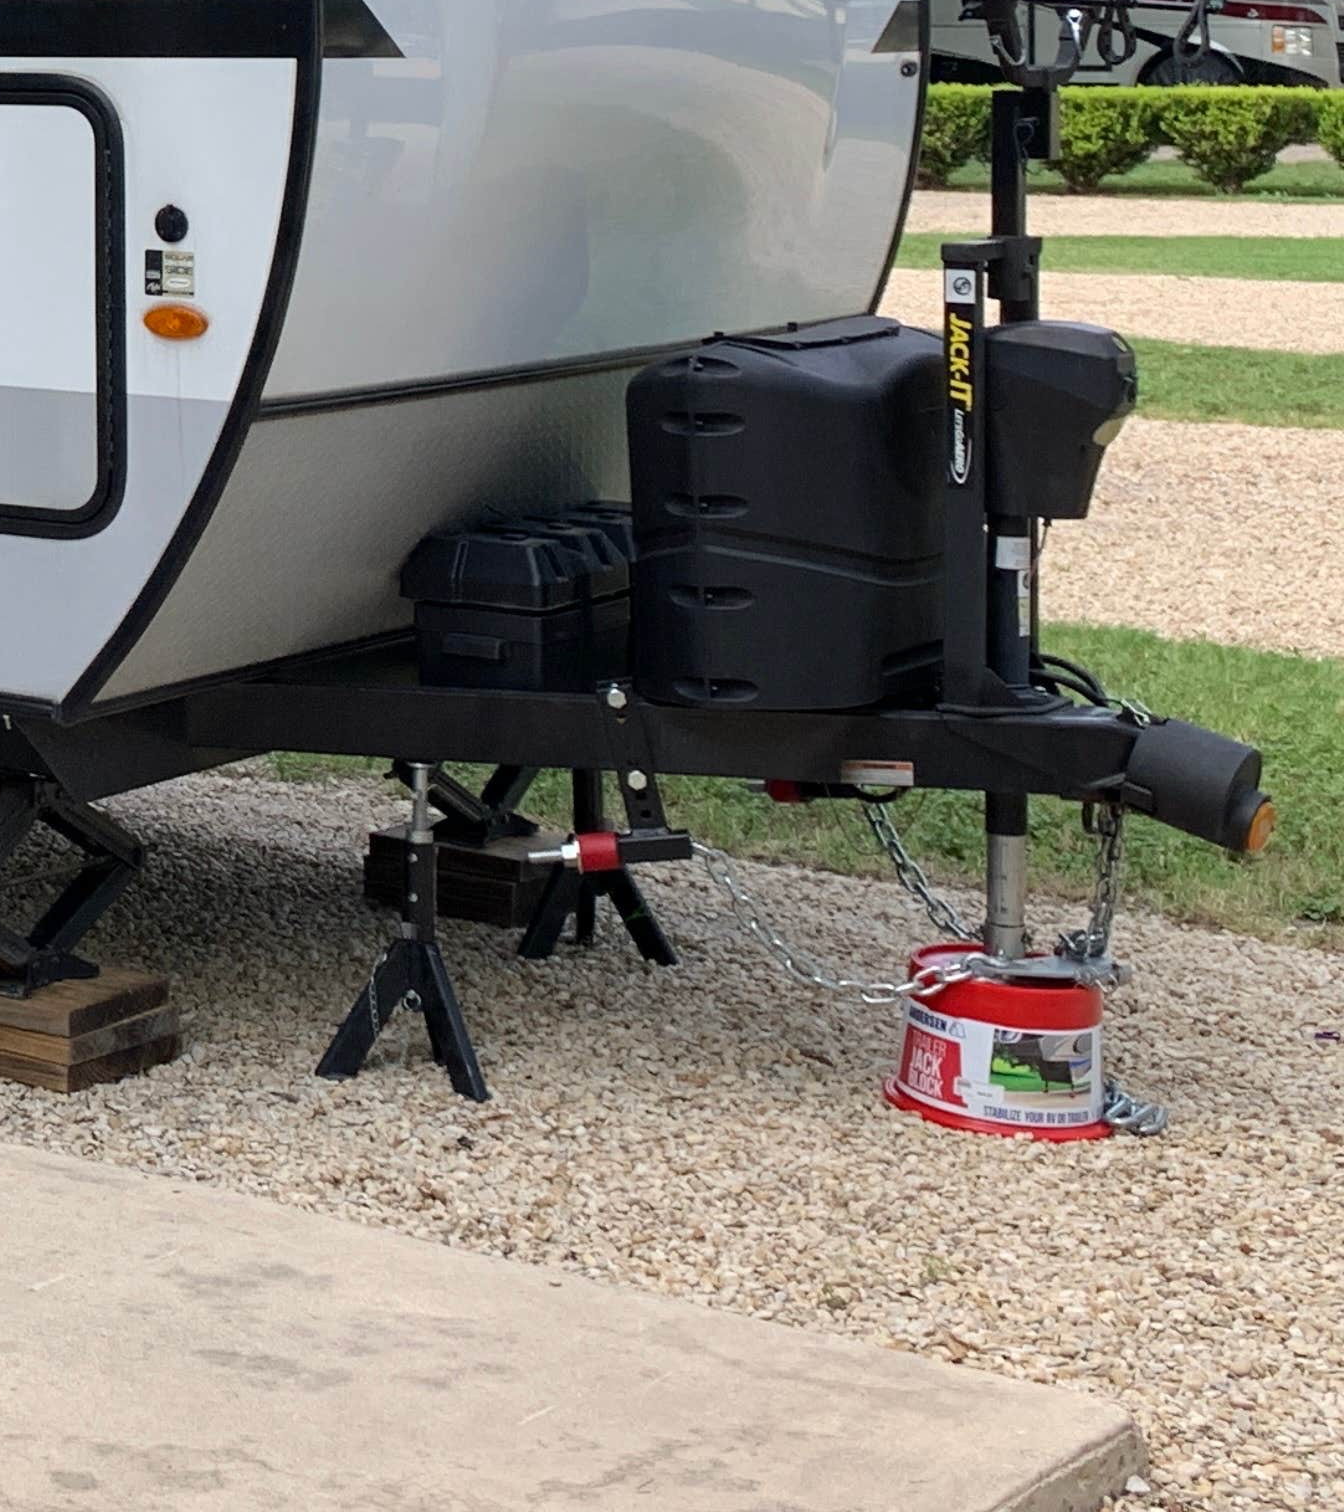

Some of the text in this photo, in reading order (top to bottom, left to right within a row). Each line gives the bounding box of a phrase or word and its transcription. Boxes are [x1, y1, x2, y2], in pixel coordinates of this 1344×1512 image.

[949, 312, 973, 412] JACK-IT
[909, 1045, 944, 1080] JACK
[907, 1066, 945, 1099] BLOCK
[984, 1105, 1022, 1121] STABILIZE
[1024, 1110, 1045, 1124] YOUR
